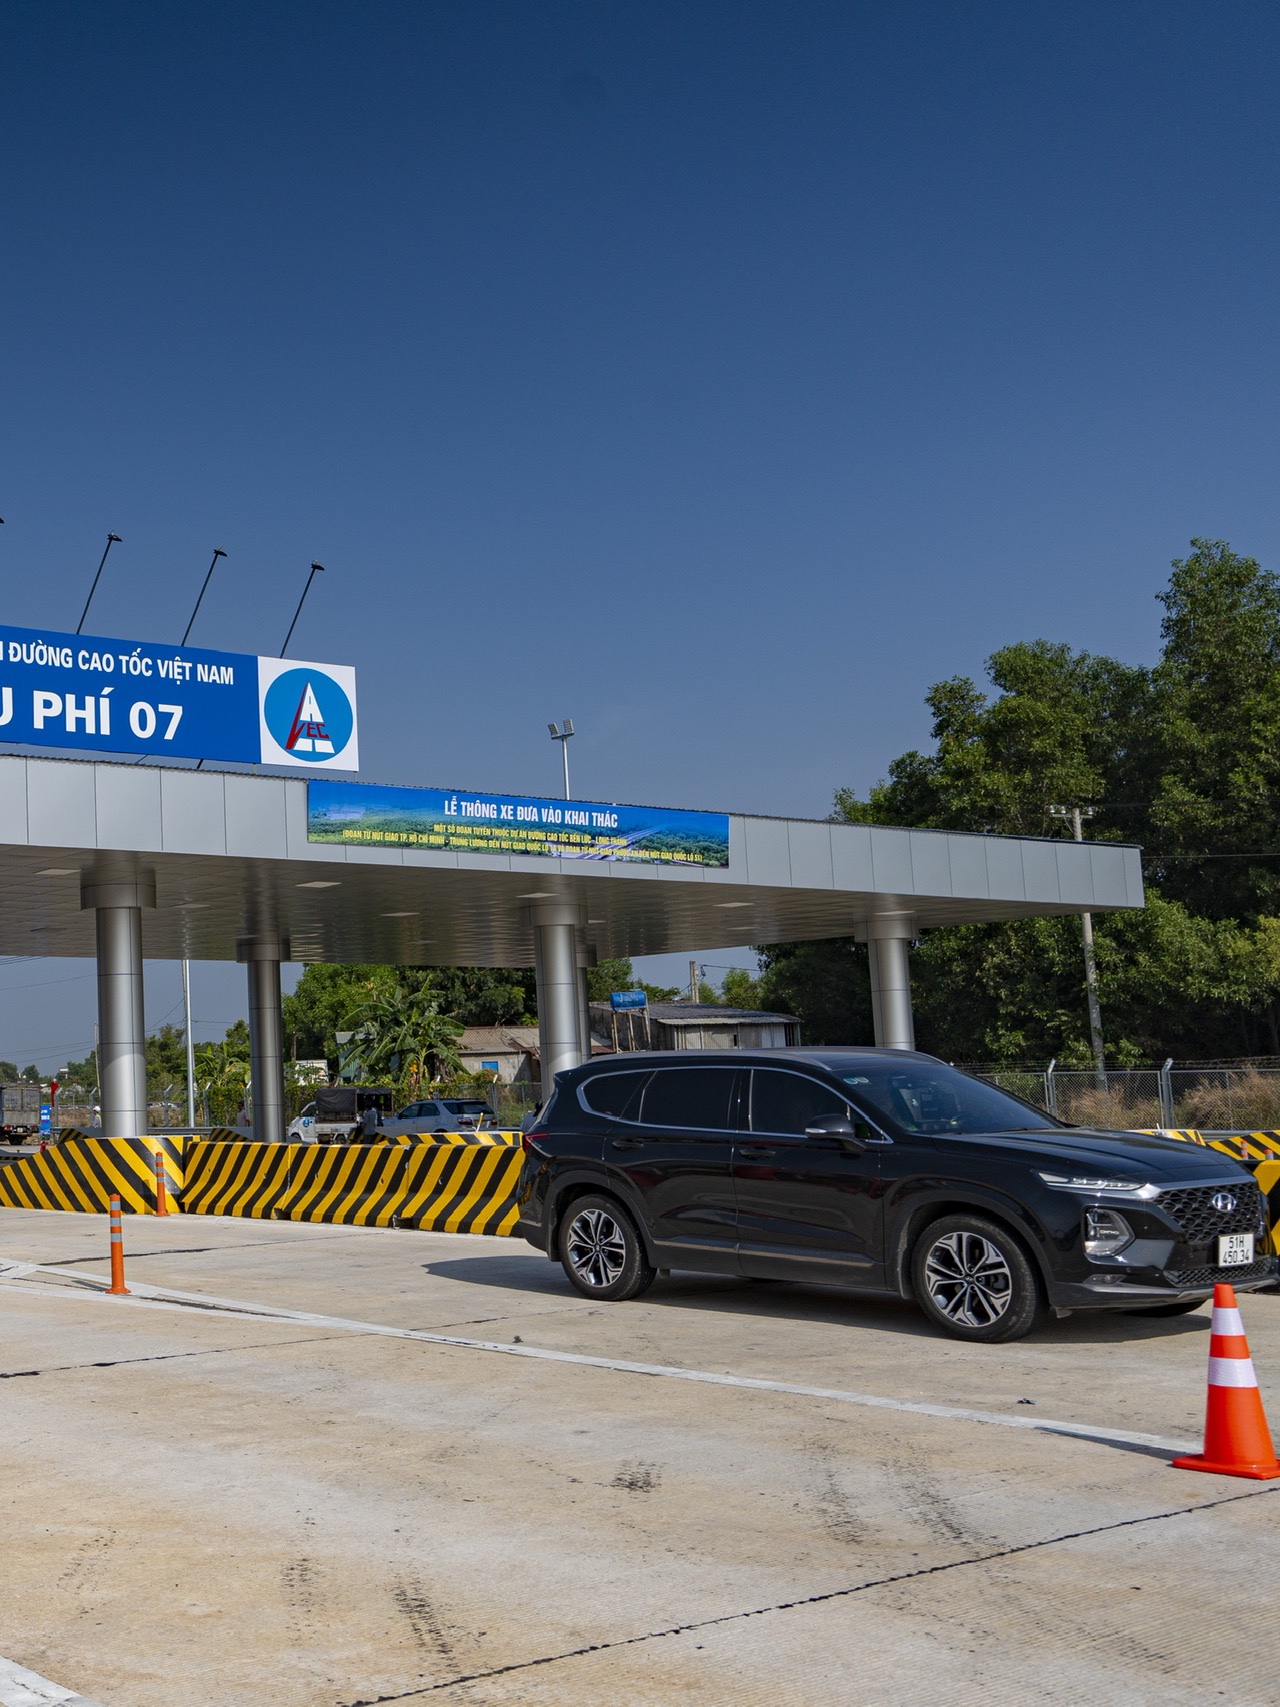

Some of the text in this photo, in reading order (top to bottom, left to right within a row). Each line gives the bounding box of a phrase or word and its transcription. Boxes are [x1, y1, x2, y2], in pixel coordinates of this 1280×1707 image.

[8, 638, 73, 668] ĐƯỜNG
[77, 650, 114, 673] CAO
[119, 647, 153, 677] TỐC
[157, 657, 192, 685] VIỆT
[197, 664, 234, 685] NAM
[33, 687, 115, 736] PHÍ
[129, 701, 184, 741] 07
[444, 796, 618, 828] LỄ THÔNG XE ĐƯA VÀO KHAI THÁC
[1223, 1249, 1250, 1264] 450.34
[1229, 1236, 1245, 1249] 51H
